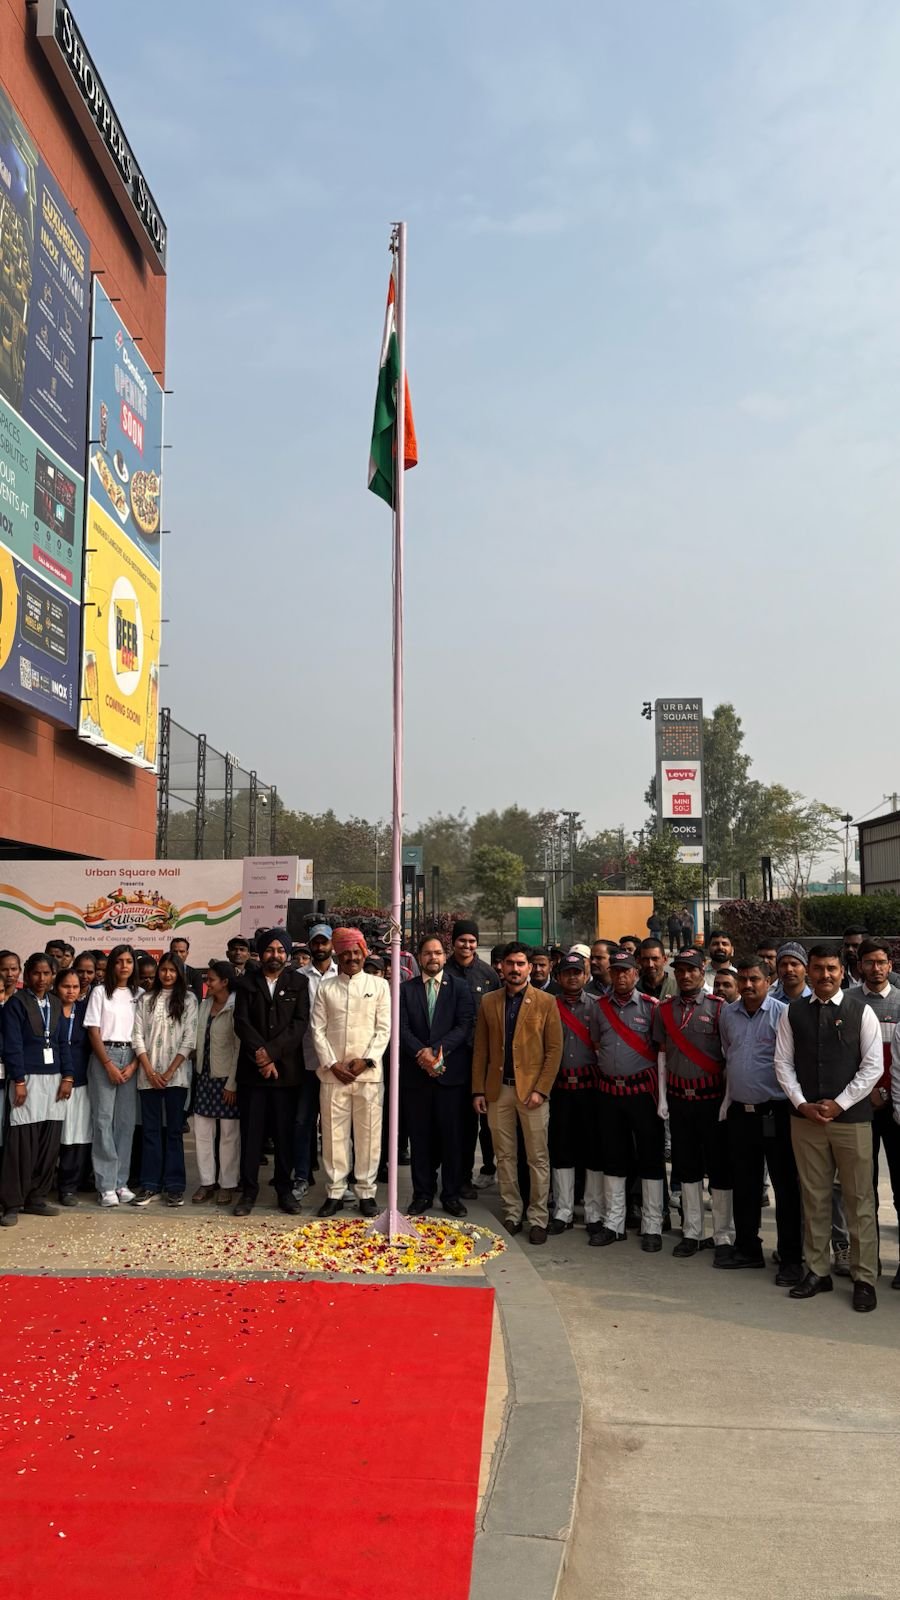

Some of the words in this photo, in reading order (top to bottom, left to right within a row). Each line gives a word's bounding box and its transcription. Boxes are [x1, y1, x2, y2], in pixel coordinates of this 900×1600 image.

[61, 7, 133, 184] SHOPPERS
[136, 174, 166, 253] STOP
[40, 226, 60, 265] INOX
[114, 363, 147, 421] OPENING
[122, 404, 143, 451] SOON
[20, 501, 30, 520] AT
[116, 615, 138, 658] BEER
[51, 679, 68, 700] INOX
[105, 694, 126, 716] COMING
[662, 703, 699, 711] URBAN
[663, 713, 699, 721] SQUARE
[85, 868, 117, 877] Urban
[119, 868, 156, 879] Square
[158, 868, 181, 877] Mall
[109, 902, 154, 918] Shaurya
